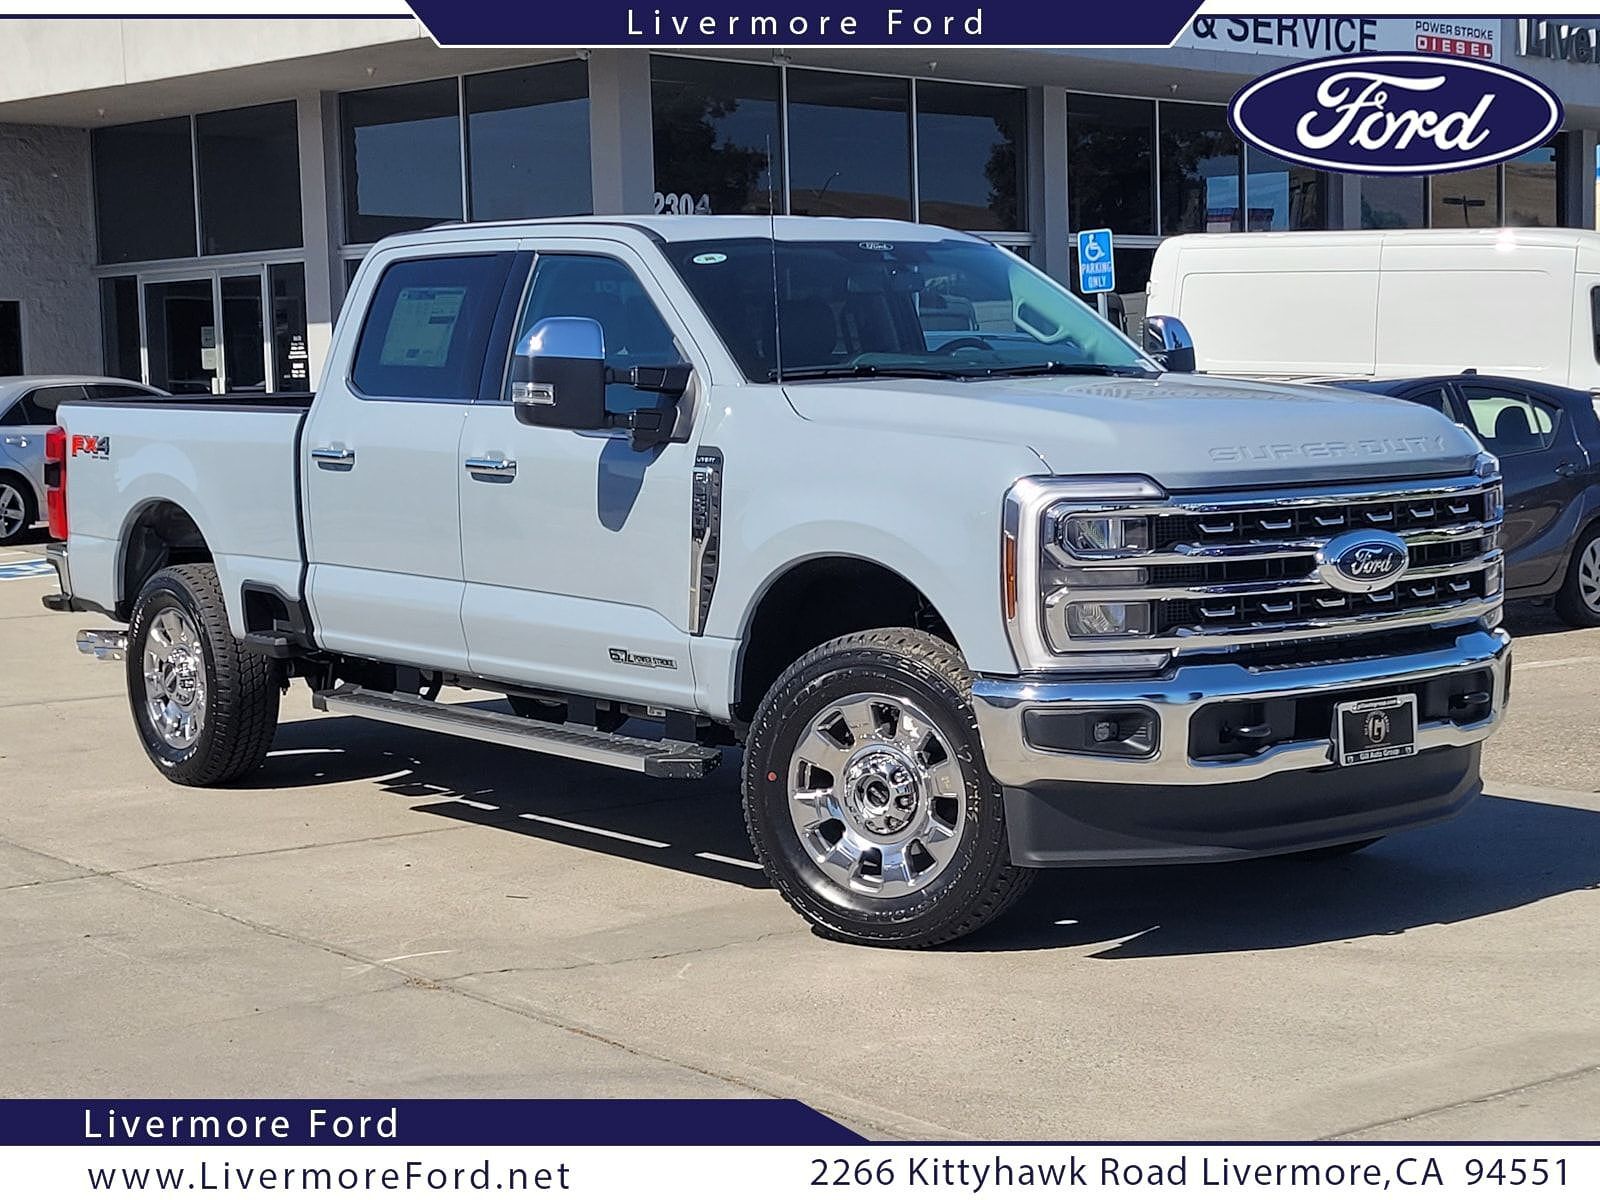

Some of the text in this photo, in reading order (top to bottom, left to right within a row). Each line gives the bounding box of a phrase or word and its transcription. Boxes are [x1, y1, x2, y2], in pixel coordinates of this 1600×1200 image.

[1227, 18, 1378, 52] SERVICE
[1415, 20, 1494, 41] POWER STROKE
[1417, 36, 1493, 58] DIESEL
[652, 192, 712, 216] 2304
[1081, 262, 1112, 274] PARKING
[1088, 275, 1106, 288] ONLY
[71, 434, 110, 457] FX4
[1208, 433, 1448, 464] SUPER DUTY
[1350, 547, 1394, 576] Ford
